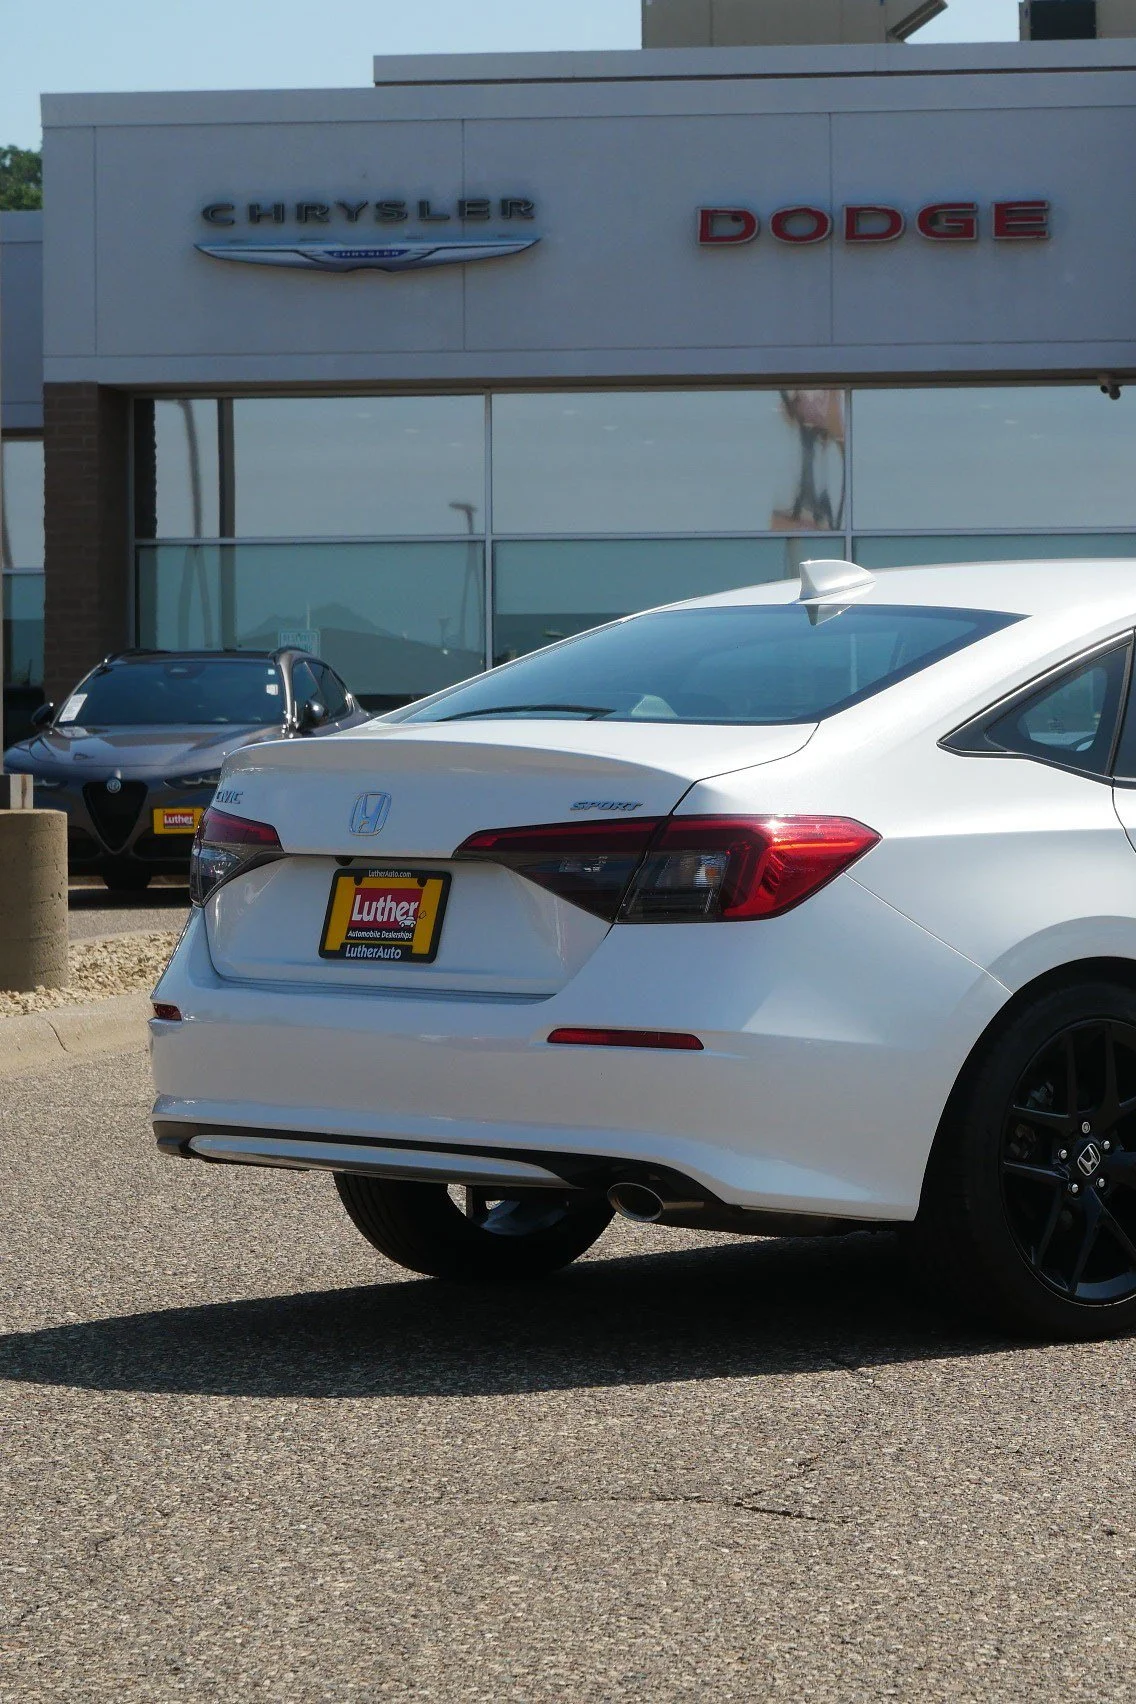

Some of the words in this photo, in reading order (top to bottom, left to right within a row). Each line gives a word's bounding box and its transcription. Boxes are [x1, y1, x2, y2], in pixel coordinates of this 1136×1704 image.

[201, 199, 536, 226] CHRYSLER
[697, 202, 1049, 244] DODGE
[215, 790, 244, 804] CIVIC
[570, 801, 644, 811] SPORT
[164, 814, 194, 824] Luther
[368, 869, 412, 878] LutherAuto.com
[351, 894, 420, 922] Luther
[347, 929, 381, 939] Automobile
[381, 930, 413, 940] Dealerships
[345, 944, 402, 959] LutherAuto
